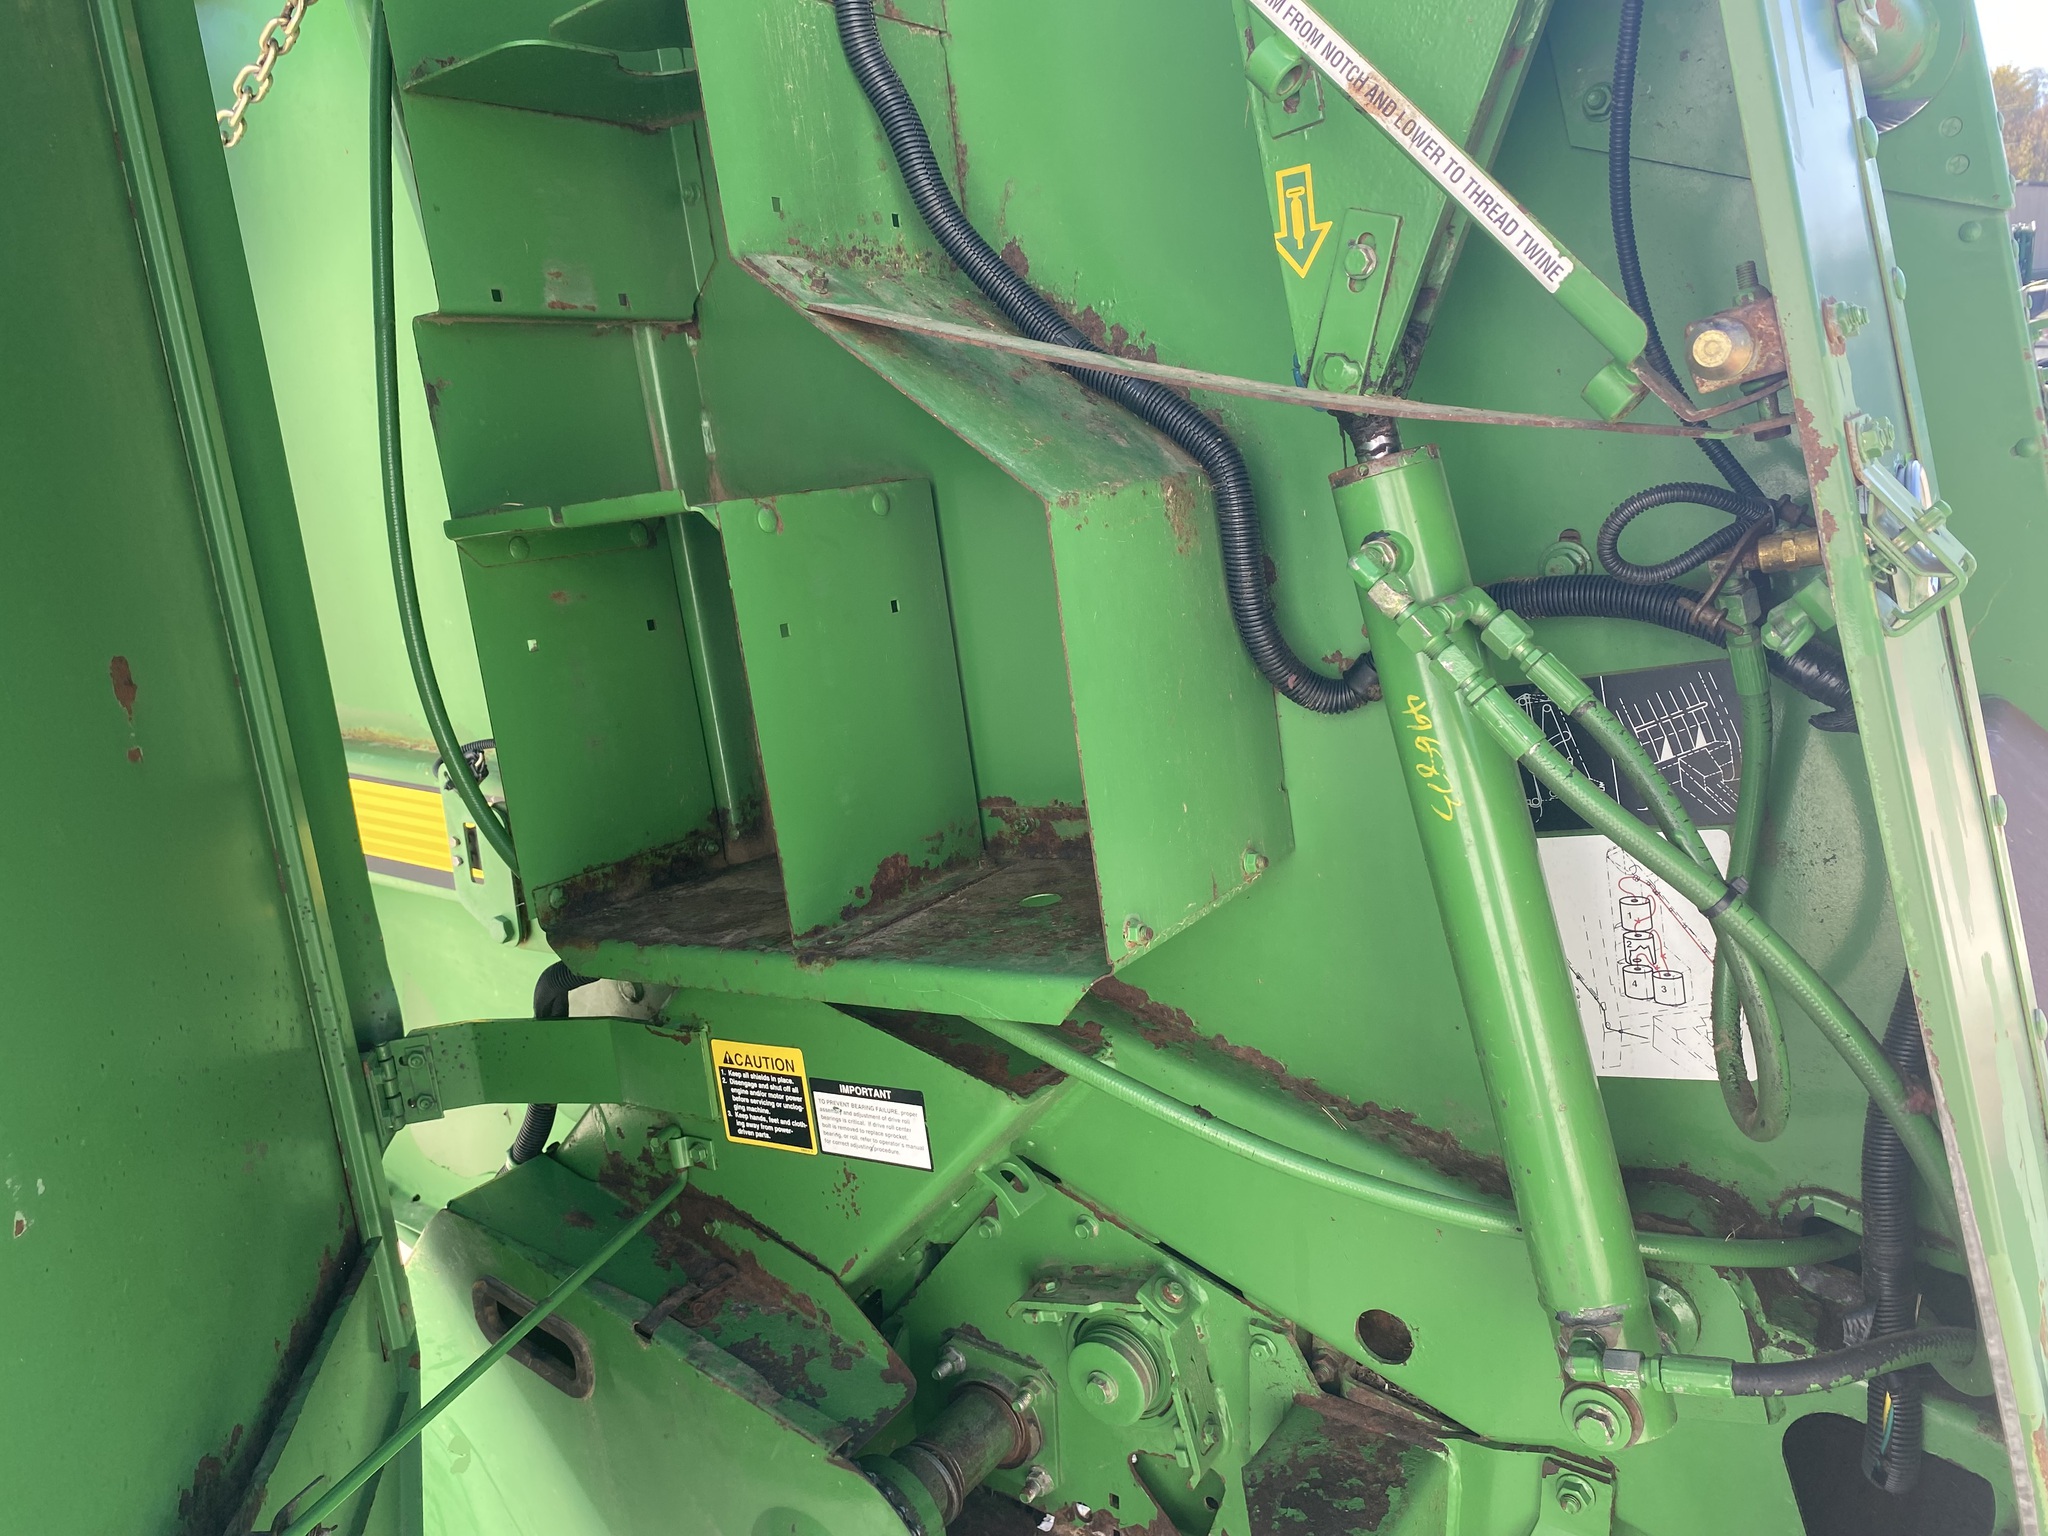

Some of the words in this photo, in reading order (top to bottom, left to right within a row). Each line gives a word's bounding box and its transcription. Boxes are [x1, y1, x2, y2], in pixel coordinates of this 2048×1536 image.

[1282, 4, 1325, 50] FROM
[1320, 41, 1371, 93] NOTCH
[1364, 83, 1398, 118] AND
[1393, 110, 1446, 165] LOWER
[1442, 157, 1465, 183] TO
[1462, 176, 1519, 236] THREAD
[1516, 230, 1564, 282] TWINE
[734, 1053, 794, 1072] CAUTION
[728, 1070, 742, 1078] Keep
[750, 1073, 770, 1081] shields
[777, 1076, 794, 1084] place.
[729, 1078, 757, 1089] Disengage
[731, 1088, 749, 1096] engine
[750, 1090, 767, 1098] and/or
[839, 1084, 891, 1099] IMPORTANT
[732, 1095, 749, 1103] before
[750, 1098, 775, 1108] servicing
[783, 1102, 804, 1112] unclog-
[851, 1103, 874, 1111] BEARING
[747, 1106, 771, 1114] machine.
[735, 1112, 748, 1120] Keep
[750, 1113, 768, 1123] hands,
[792, 1120, 807, 1128] cloth-
[821, 1115, 841, 1123] bearings
[853, 1112, 880, 1120] adjustment
[888, 1115, 900, 1123] drive
[736, 1120, 745, 1128] ing
[746, 1122, 759, 1130] away
[761, 1123, 773, 1131] from
[774, 1126, 793, 1134] power-
[838, 1125, 858, 1133] removed
[866, 1129, 884, 1138] replace
[738, 1129, 754, 1137] driven
[755, 1131, 771, 1139] parts.
[823, 1131, 842, 1139] bearing,
[874, 1144, 900, 1155] procedure.
